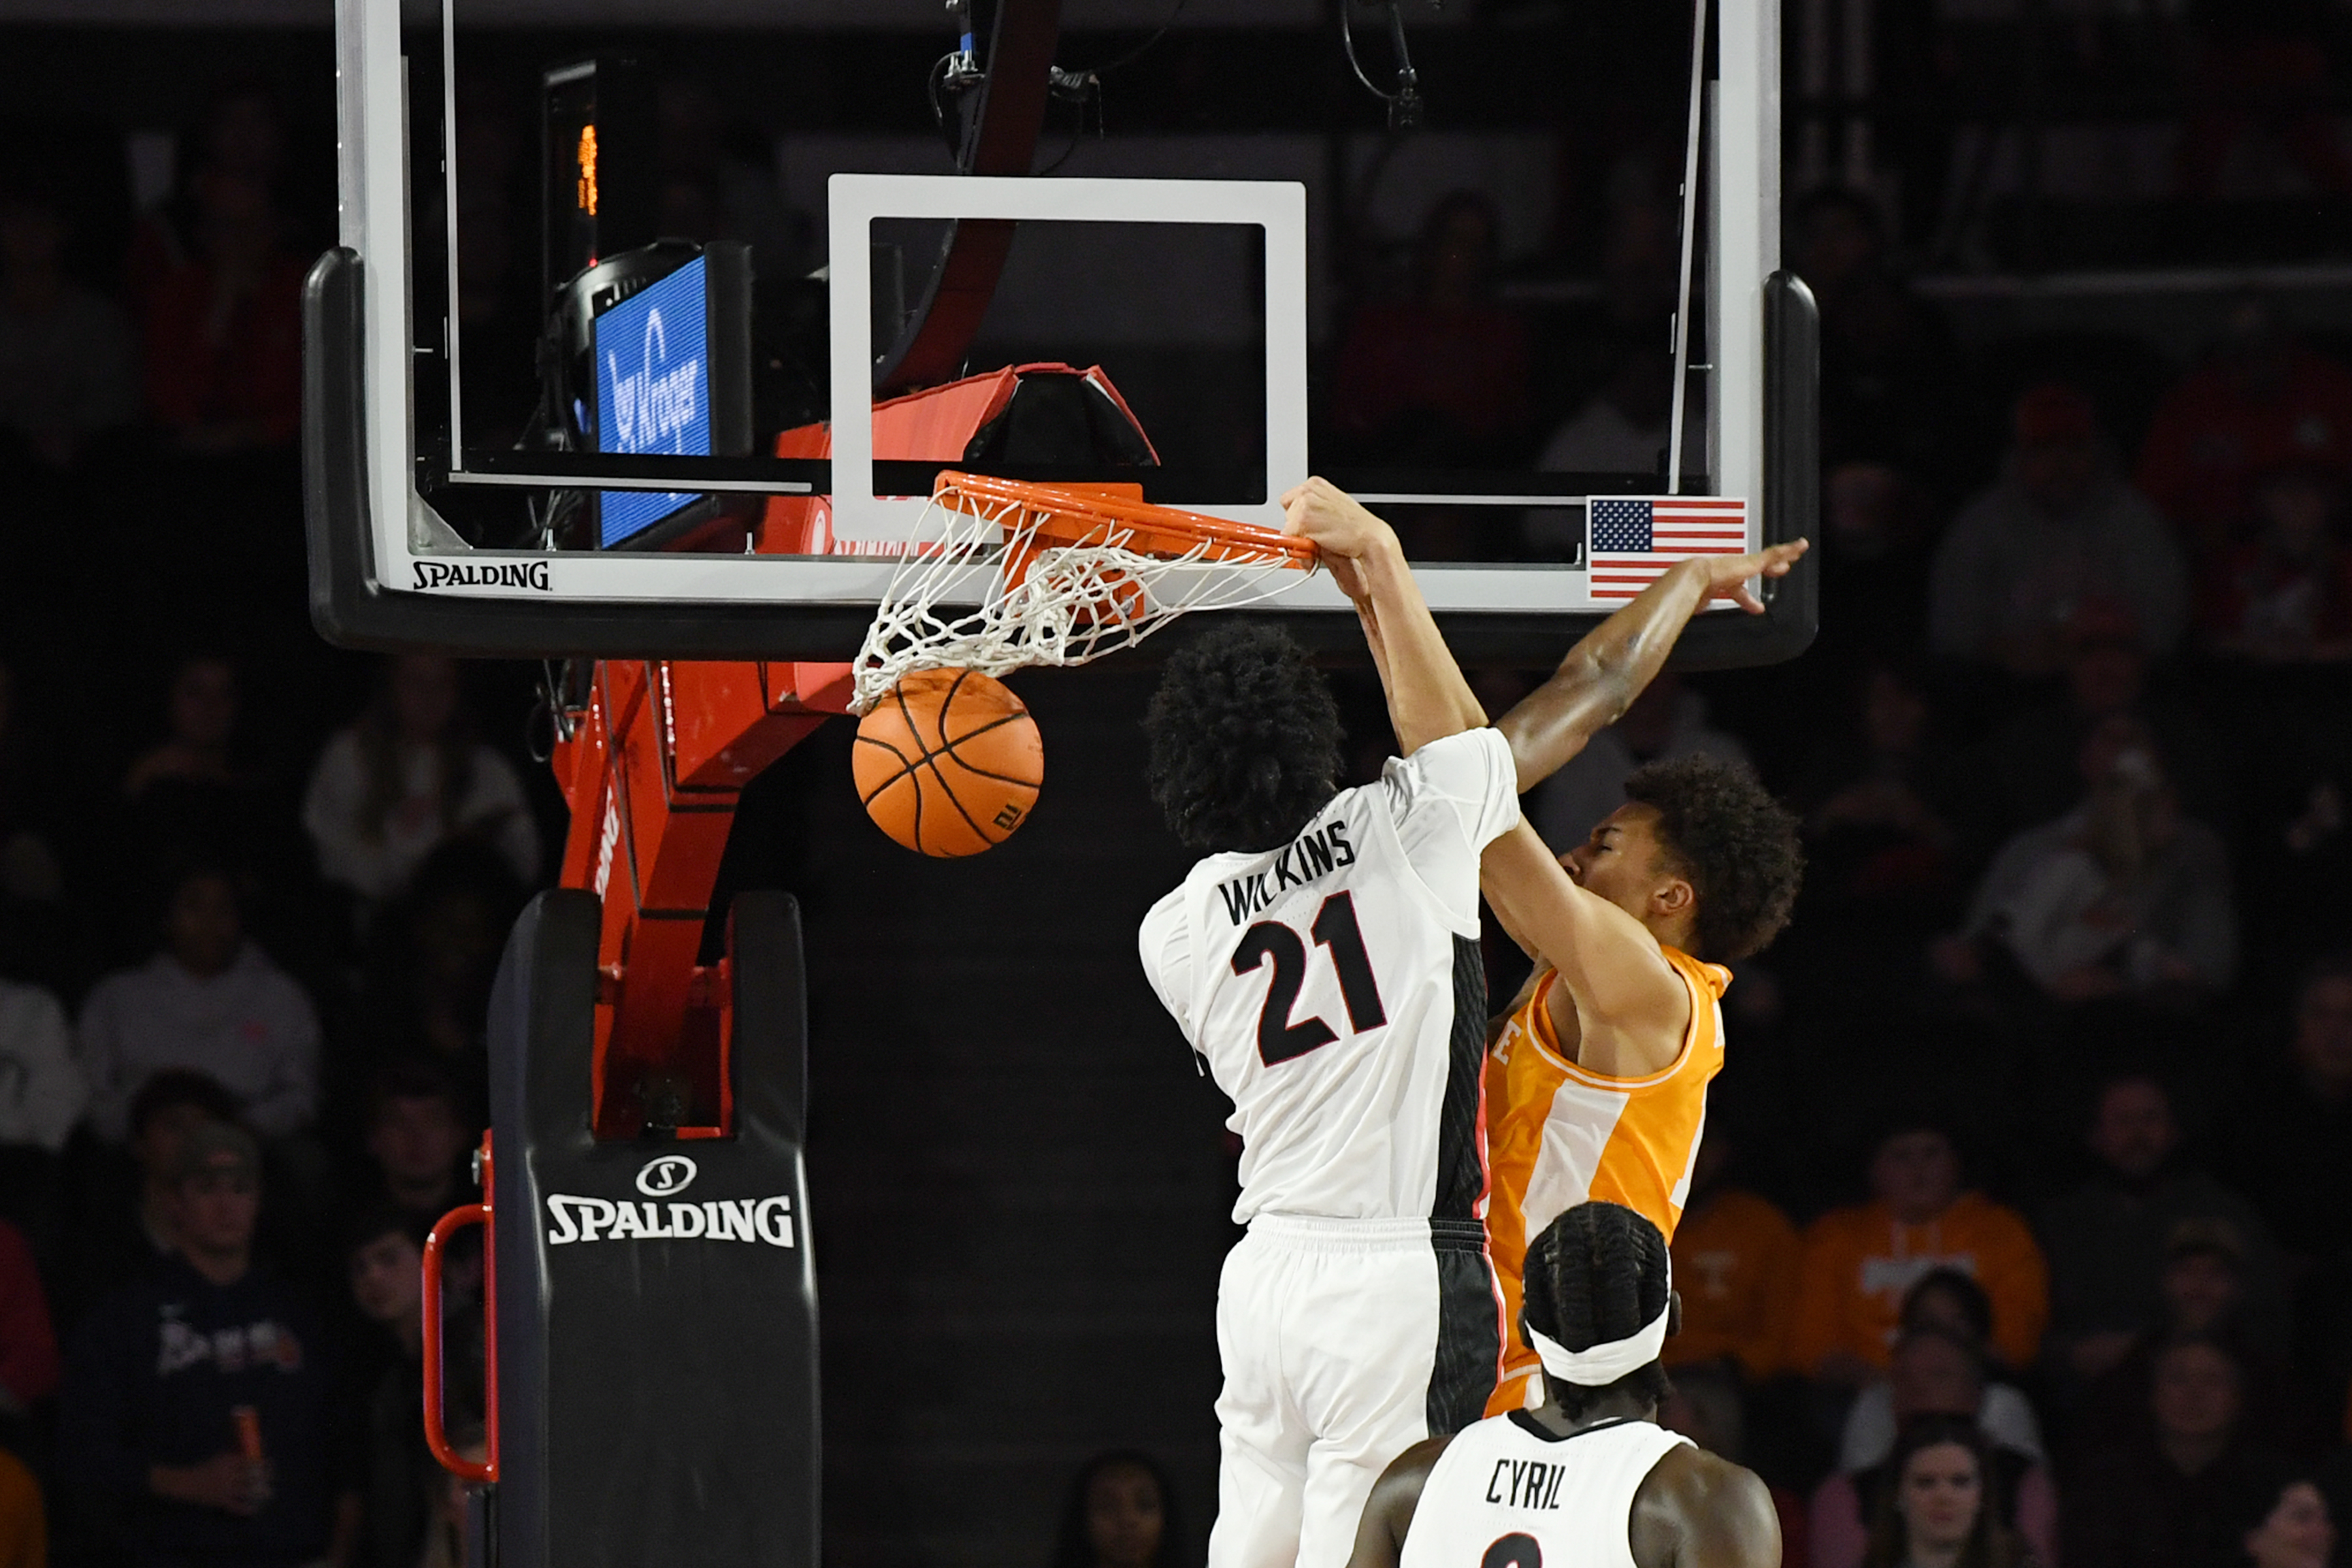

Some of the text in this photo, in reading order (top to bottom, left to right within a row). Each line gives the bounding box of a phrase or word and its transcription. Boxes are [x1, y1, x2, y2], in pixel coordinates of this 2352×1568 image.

[636, 308, 699, 461] Kroger
[413, 561, 549, 591] SPALDING
[1217, 821, 1356, 926] WILKINS
[1231, 889, 1388, 1068] 21
[547, 1194, 795, 1249] SPALDING
[1485, 1458, 1567, 1510] CYRIL
